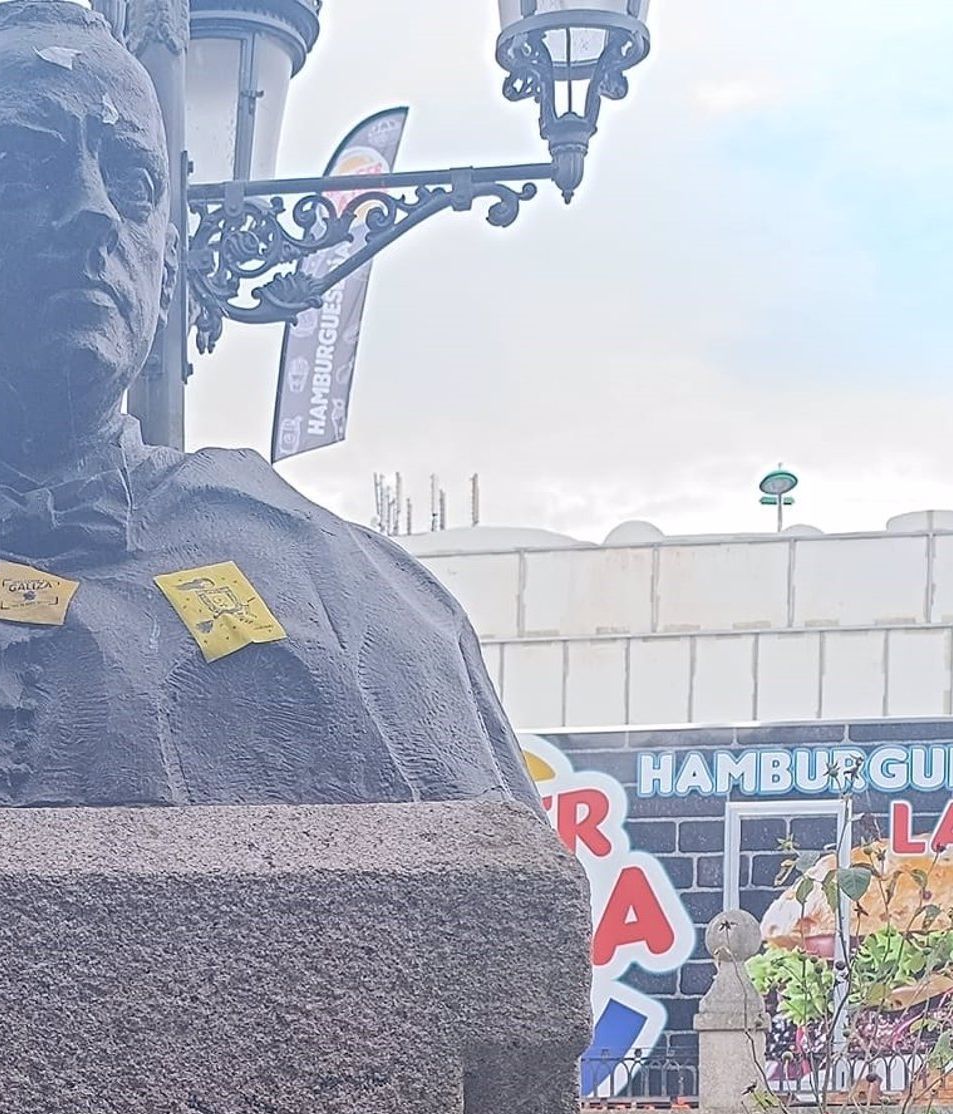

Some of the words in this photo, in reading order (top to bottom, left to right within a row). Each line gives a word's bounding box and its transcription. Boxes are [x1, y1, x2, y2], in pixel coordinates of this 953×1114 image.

[307, 244, 353, 436] HAMBURGUESÍA
[8, 580, 53, 593] GALIZA
[640, 748, 953, 795] HAMBURGU
[542, 788, 612, 858] R
